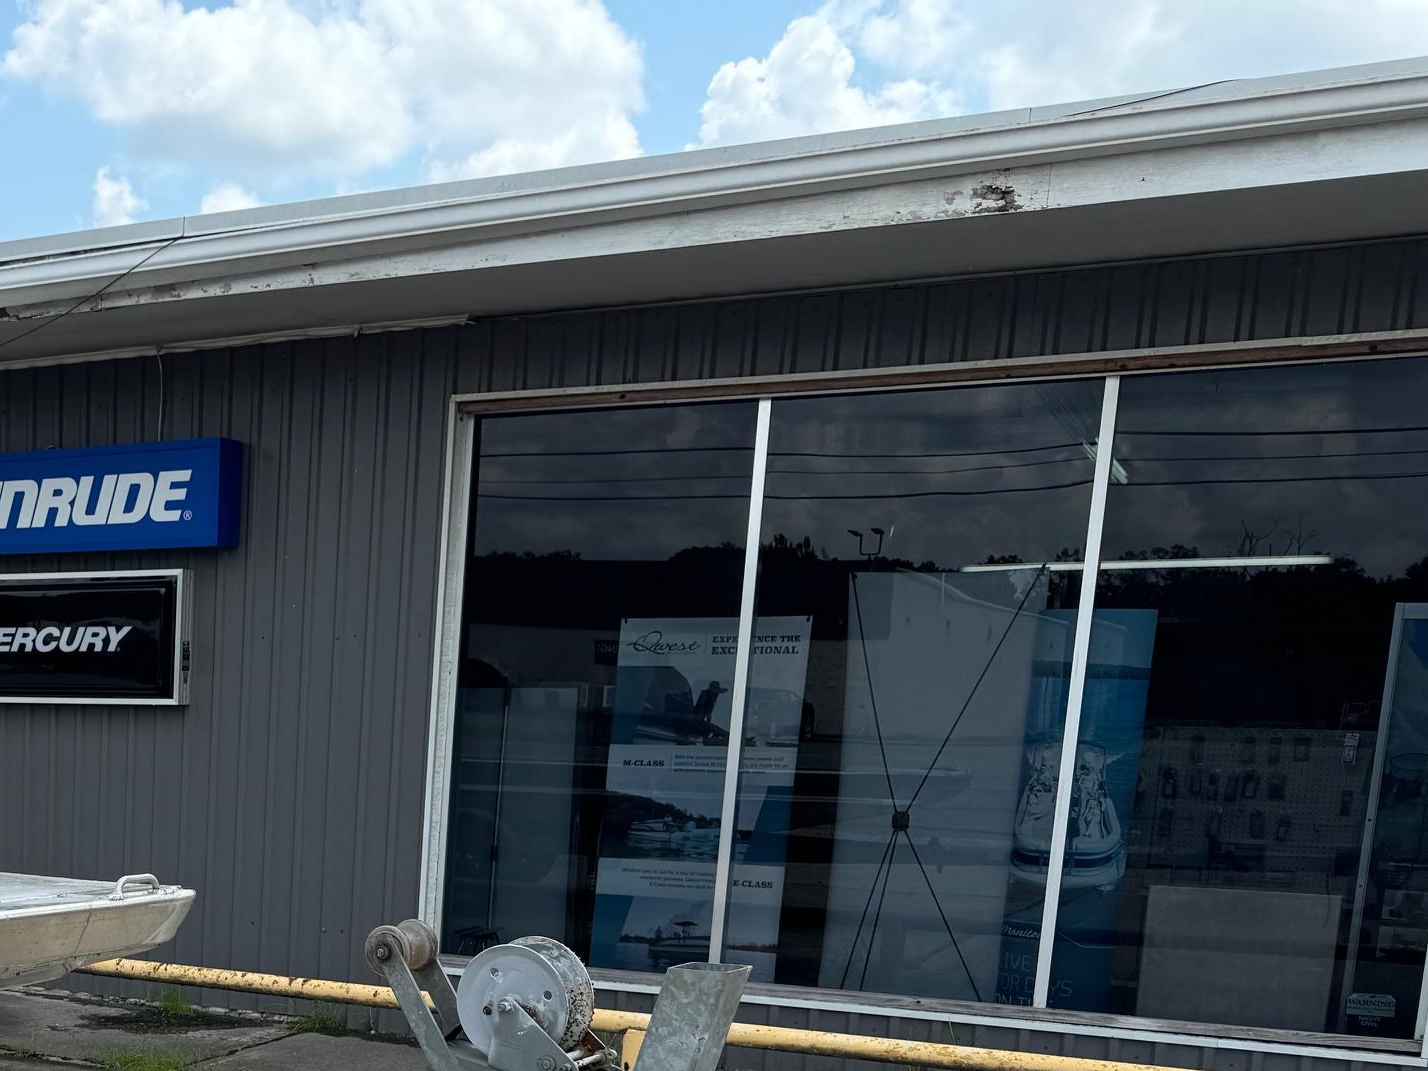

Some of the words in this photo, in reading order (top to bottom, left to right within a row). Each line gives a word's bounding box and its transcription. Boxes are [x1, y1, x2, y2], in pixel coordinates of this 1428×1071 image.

[626, 630, 701, 655] Qwest
[712, 635, 777, 643] EXPENCE
[779, 635, 801, 643] THE
[711, 645, 799, 655] EXCTIONAL
[622, 759, 665, 767] M-CLASS
[732, 879, 774, 889] E-CLASS
[1004, 951, 1030, 972] IVE
[1024, 976, 1072, 997] DYS
